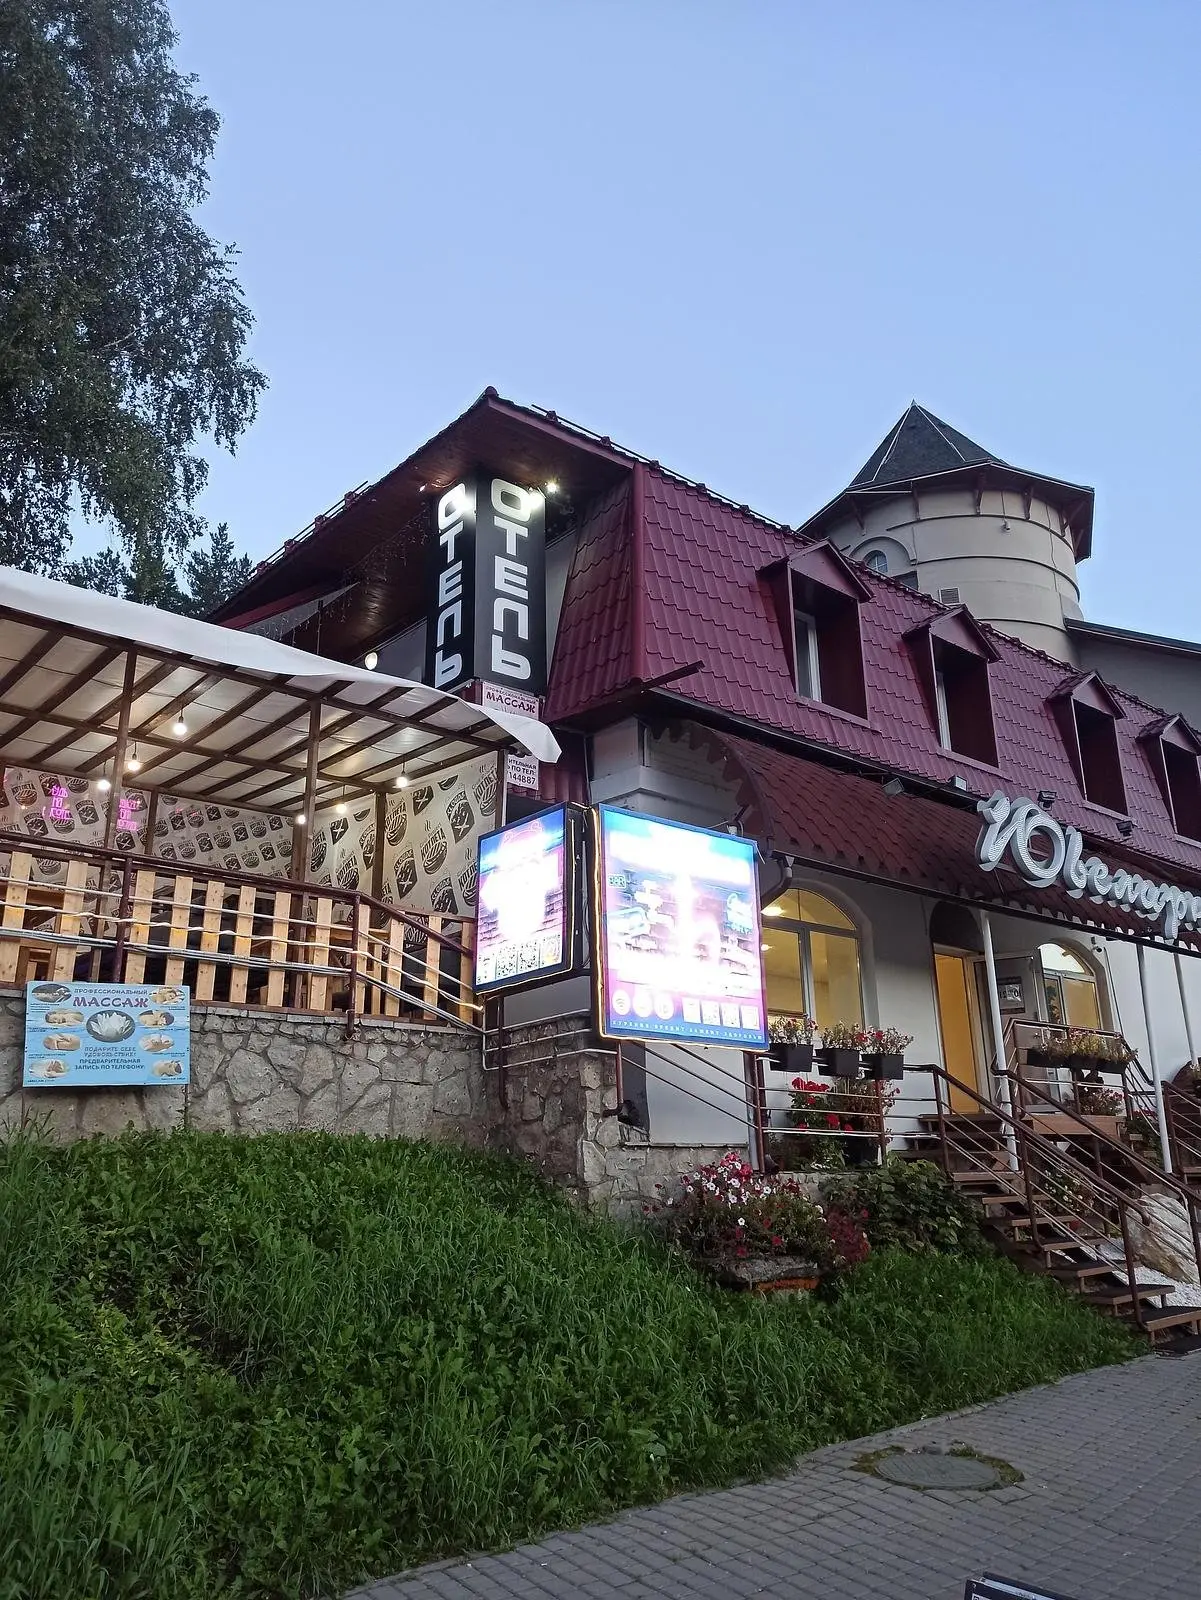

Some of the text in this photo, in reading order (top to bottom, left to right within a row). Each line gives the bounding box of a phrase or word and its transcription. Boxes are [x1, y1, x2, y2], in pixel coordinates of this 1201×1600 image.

[435, 483, 467, 690] ОТЕЛЬ
[491, 478, 534, 680] ОТЕЛЬ
[486, 691, 536, 714] МАССАЖ
[508, 758, 537, 770] ИТЕЛЬНАЯ
[508, 771, 536, 784] 144887
[73, 996, 149, 1008] МАССАЖ
